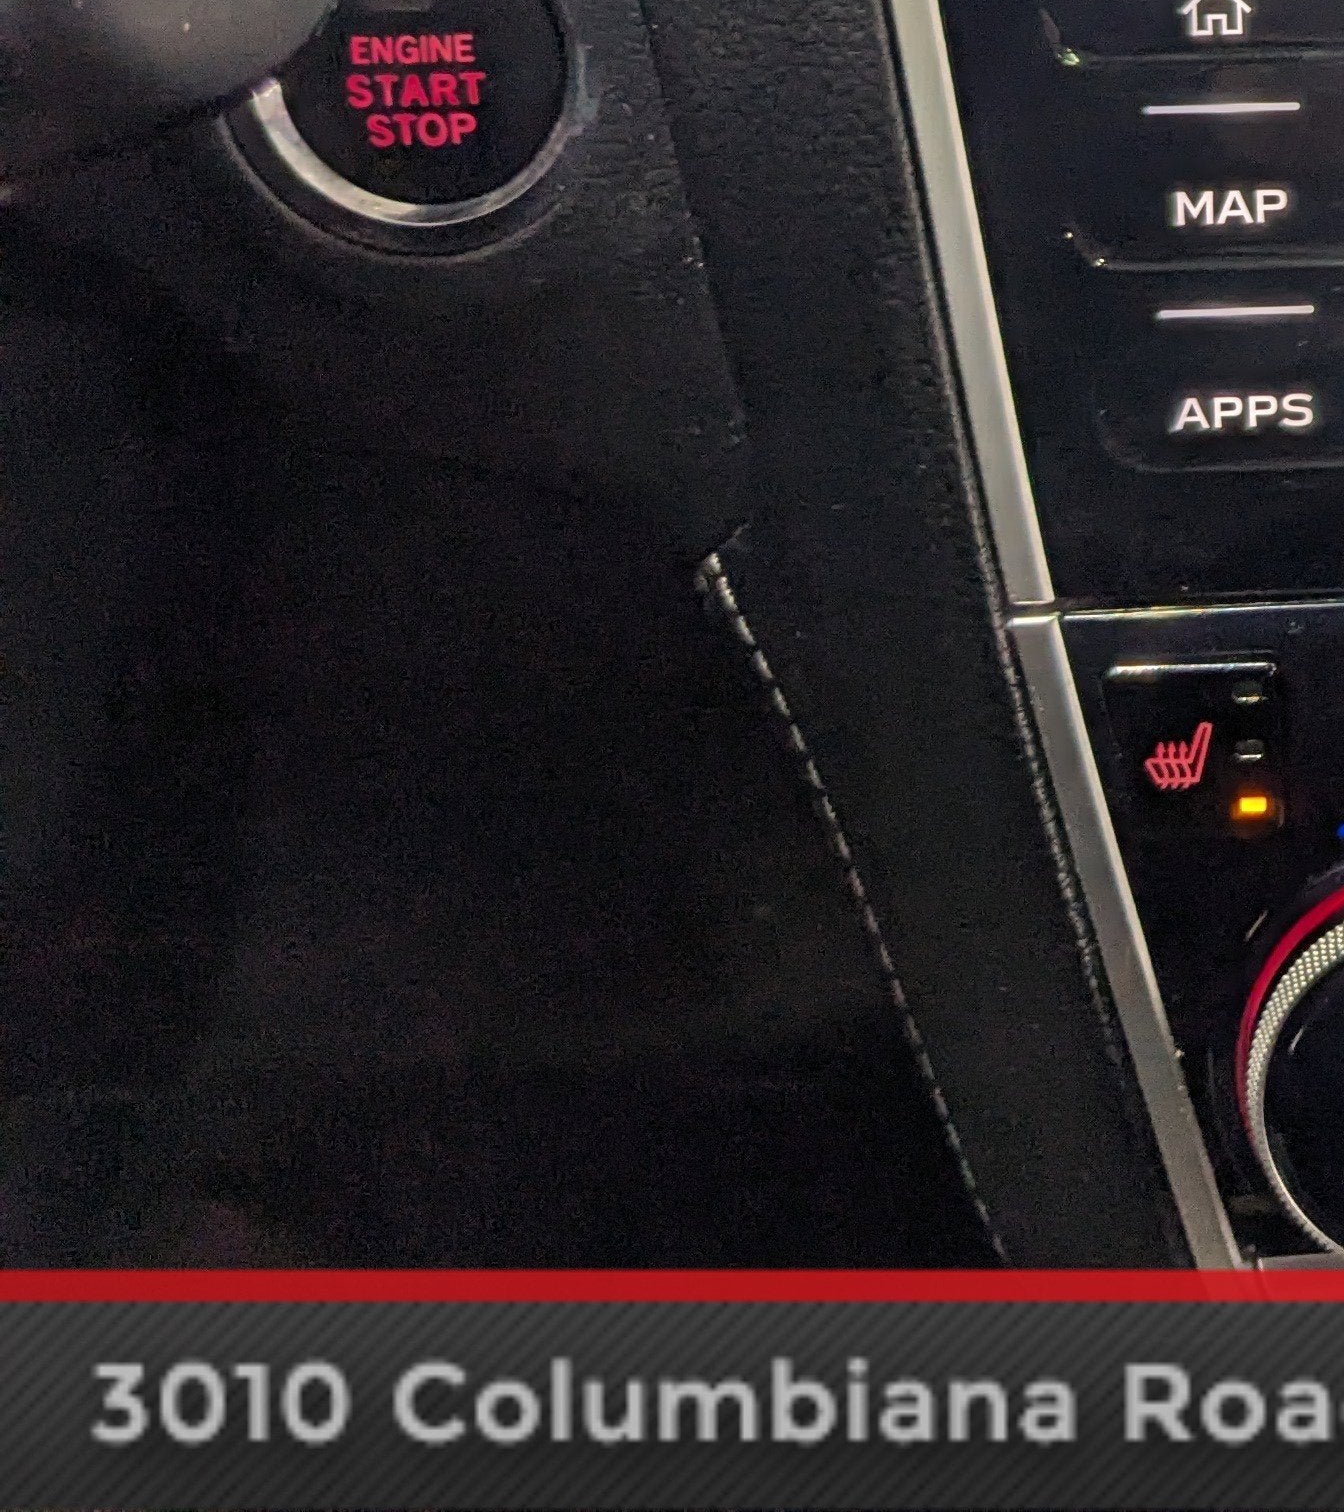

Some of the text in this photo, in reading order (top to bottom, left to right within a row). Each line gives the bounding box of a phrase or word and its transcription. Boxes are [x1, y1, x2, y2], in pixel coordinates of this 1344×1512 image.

[350, 33, 476, 65] ENGINE
[346, 72, 486, 110] START
[366, 113, 478, 149] STOP
[1173, 189, 1289, 226] MAP
[1168, 392, 1315, 433] APPS
